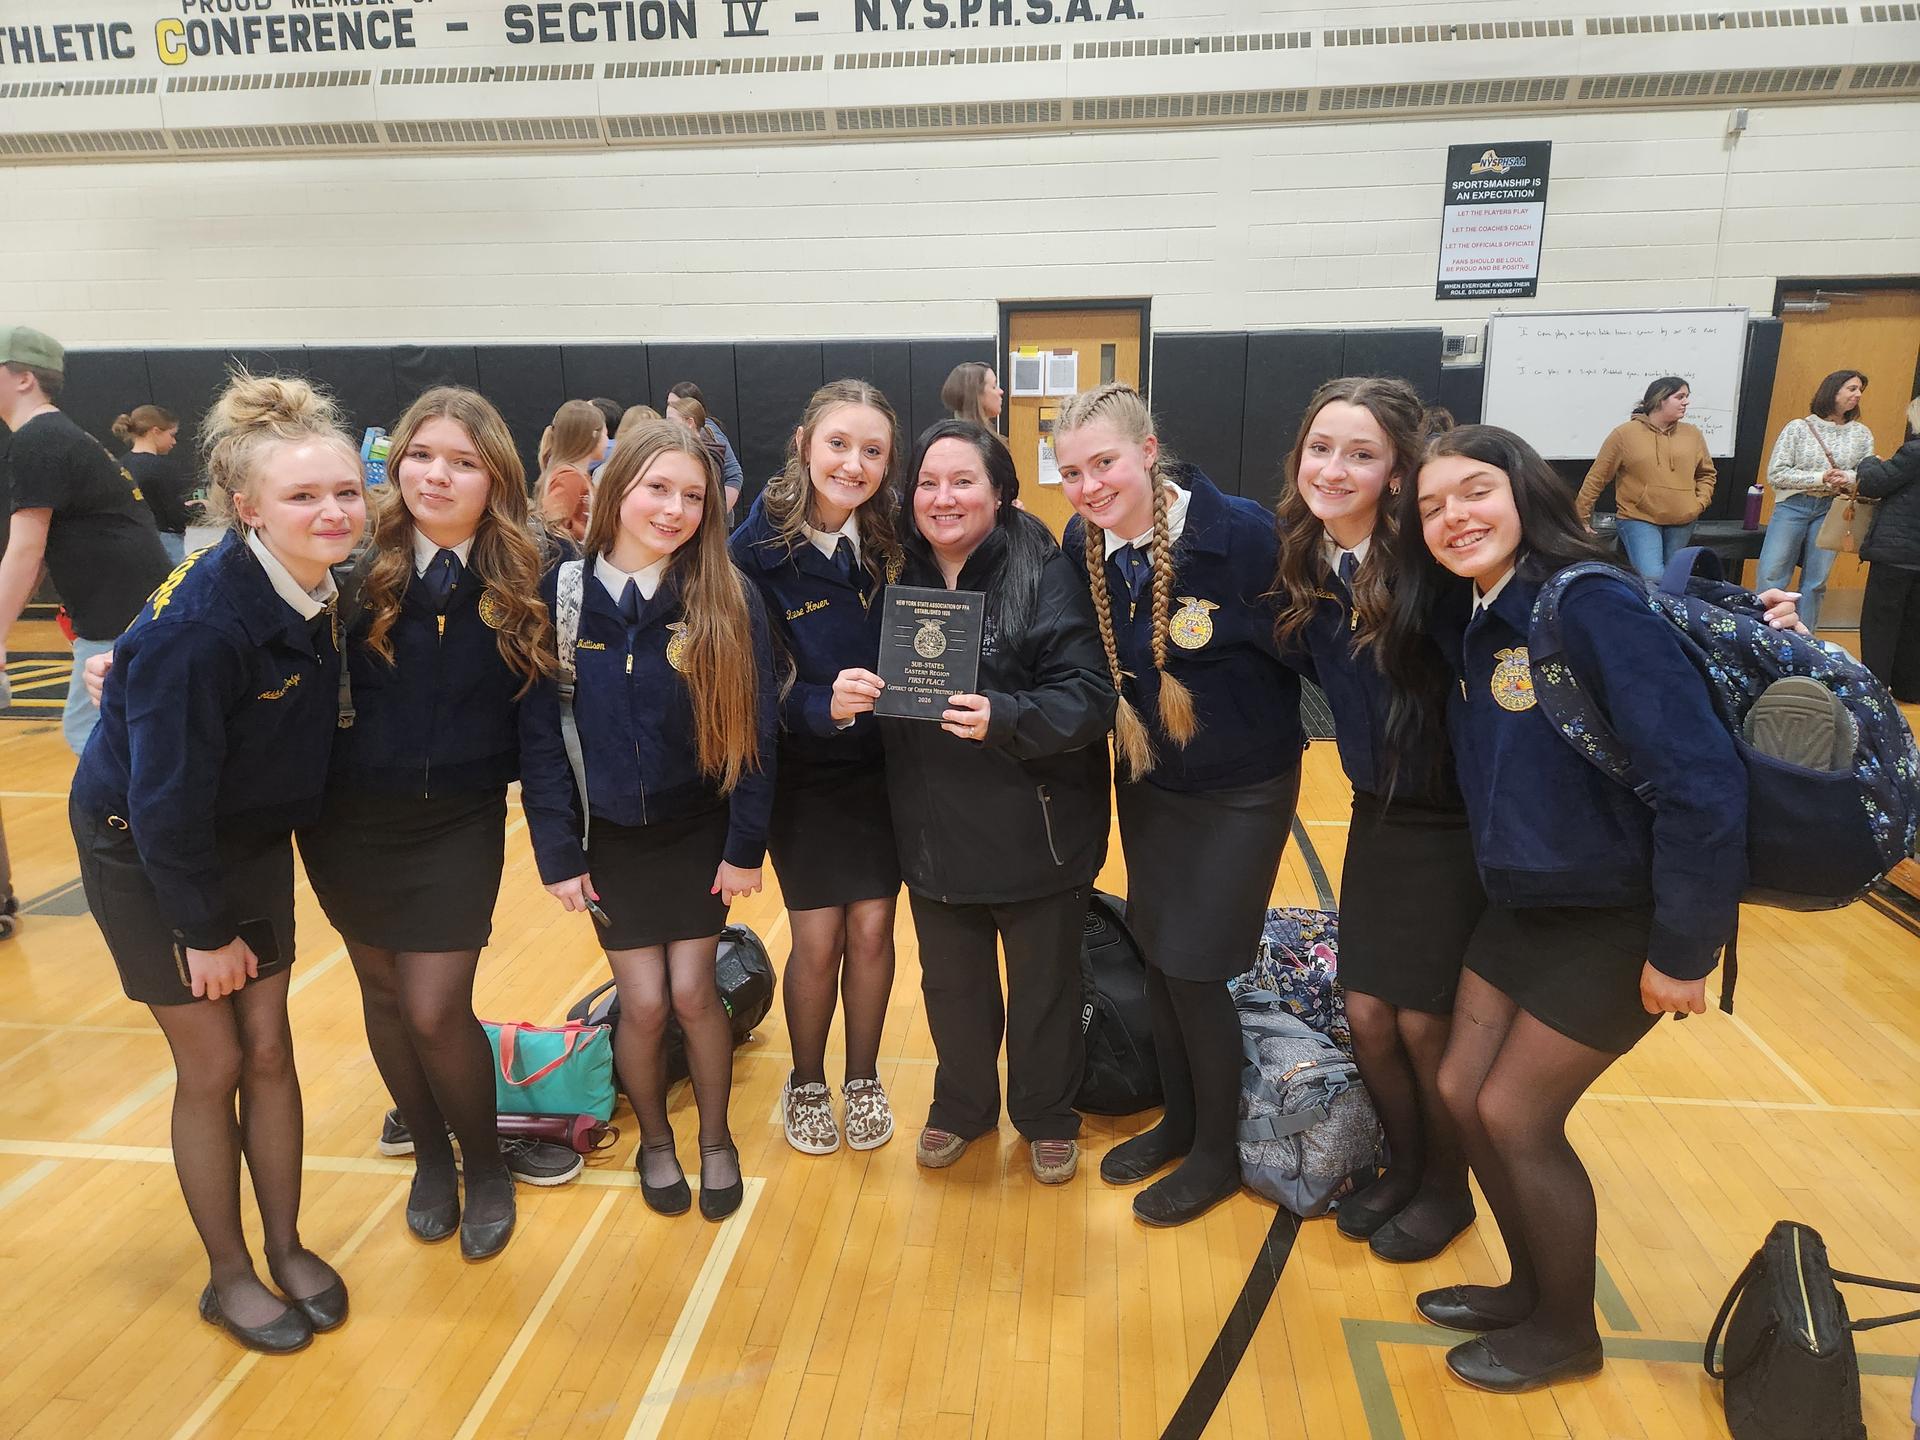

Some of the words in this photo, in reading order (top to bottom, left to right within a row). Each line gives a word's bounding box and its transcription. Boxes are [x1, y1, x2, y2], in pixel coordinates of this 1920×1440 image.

[155, 8, 416, 66] CONFERENCE
[504, 0, 698, 44] SECTION
[722, 0, 769, 37] IV
[1480, 156, 1527, 168] NYSPHSAA
[1452, 179, 1531, 190] SPORTSMANSHIP
[1532, 178, 1542, 187] IS
[1456, 192, 1470, 200] AN
[1472, 189, 1535, 200] EXPECTATION
[1484, 208, 1512, 216] PLAYERS
[1503, 240, 1535, 248] OFFICIATE
[930, 602, 956, 610] ASSOCIATION
[910, 660, 945, 670] SUB-STATES
[904, 667, 929, 675] EASTERN
[907, 676, 925, 685] FIRST
[925, 678, 946, 686] PLACE
